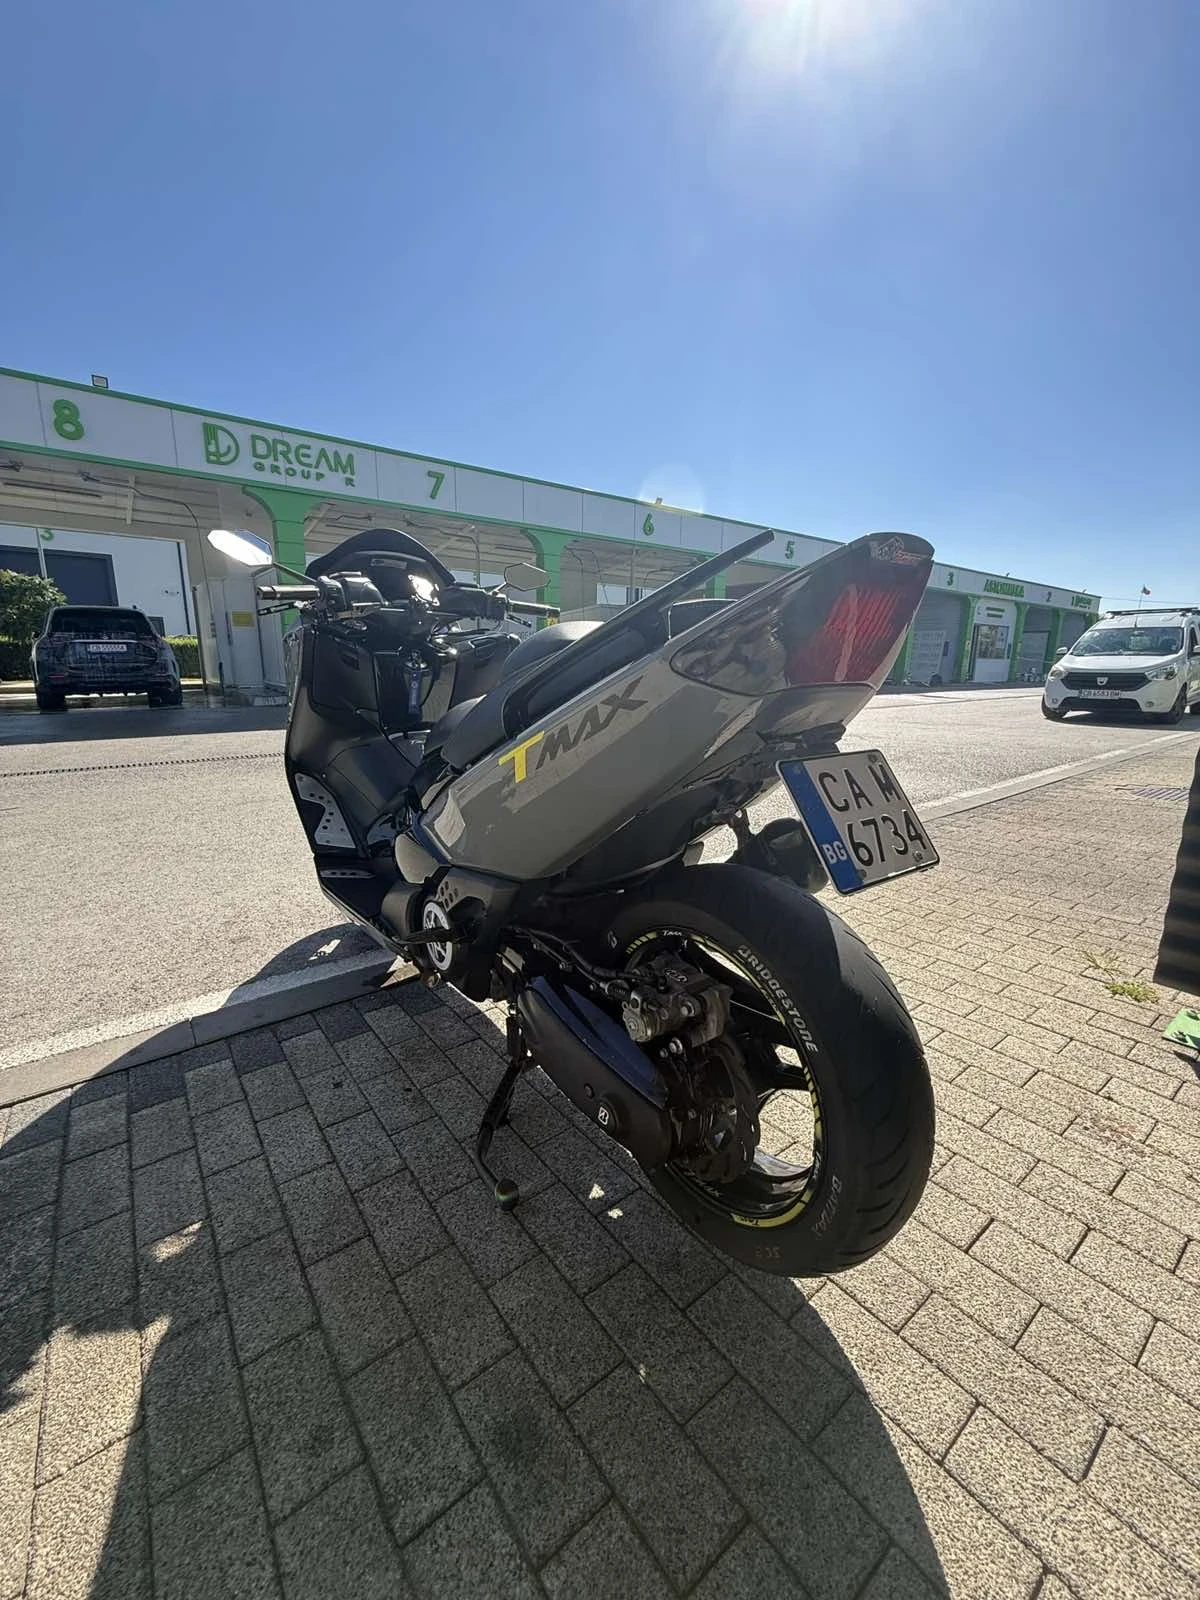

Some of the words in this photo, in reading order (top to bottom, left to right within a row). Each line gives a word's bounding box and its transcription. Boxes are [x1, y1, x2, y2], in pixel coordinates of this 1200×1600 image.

[52, 398, 85, 441] 8
[251, 434, 356, 476] DREAM
[253, 461, 326, 482] GROUP
[425, 470, 446, 500] 7
[642, 512, 655, 537] 6
[784, 540, 796, 560] 5
[947, 572, 955, 586] 3
[498, 674, 649, 784] TMAX
[817, 768, 873, 813] CA
[868, 763, 902, 803] M
[820, 840, 849, 865] BG
[846, 808, 927, 867] 6734
[738, 944, 819, 1053] BRIDGESTONE
